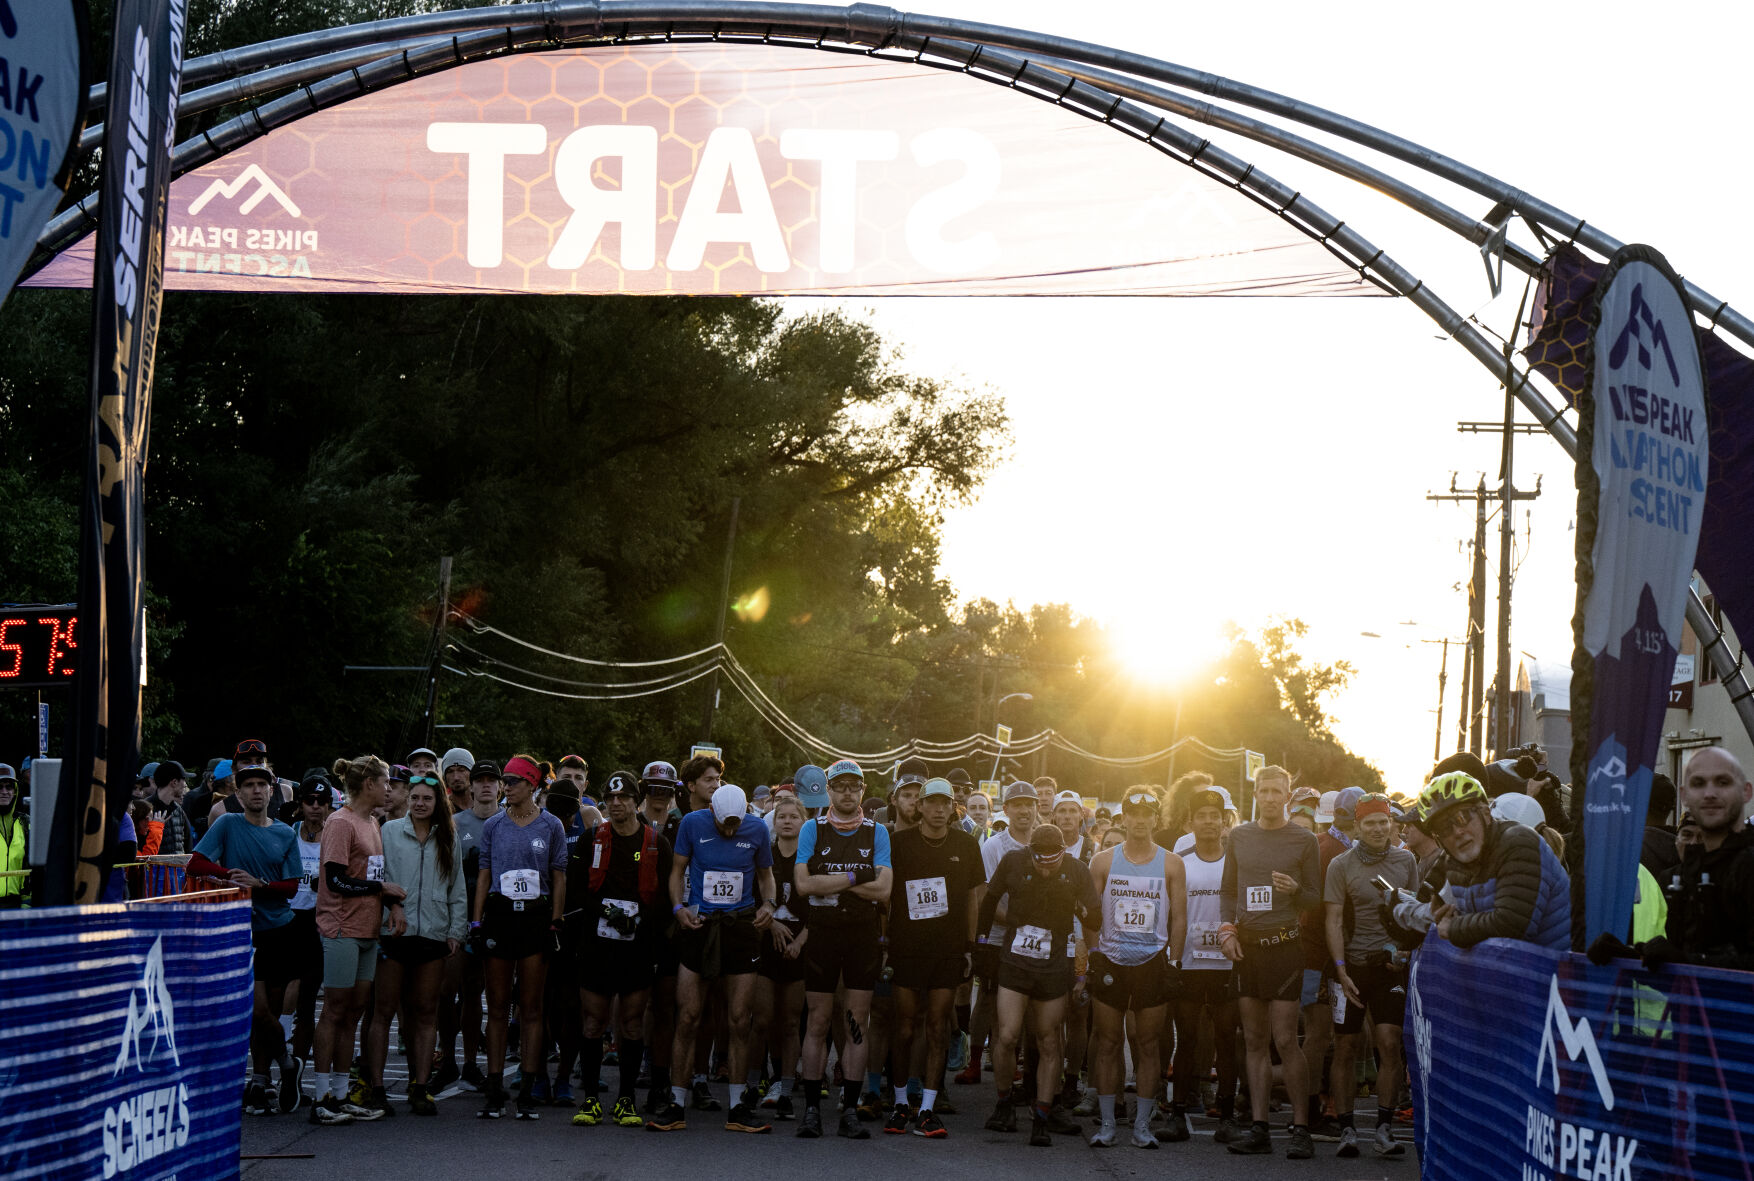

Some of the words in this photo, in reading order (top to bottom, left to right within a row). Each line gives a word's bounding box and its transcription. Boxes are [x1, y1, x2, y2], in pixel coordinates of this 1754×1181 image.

[114, 24, 150, 320] SERIES
[1628, 478, 1692, 535] SCENT
[736, 841, 751, 849] AFAS
[513, 881, 528, 893] 30
[712, 885, 734, 896] 132
[1111, 889, 1161, 899] GUATEMALA
[917, 891, 938, 905] 188
[1250, 891, 1270, 904] 110
[1123, 912, 1146, 926] 120
[1020, 937, 1042, 952] 144
[103, 1081, 190, 1180] SCHEELS
[1526, 1104, 1555, 1169] PIKES
[1560, 1122, 1638, 1181] PEAK
